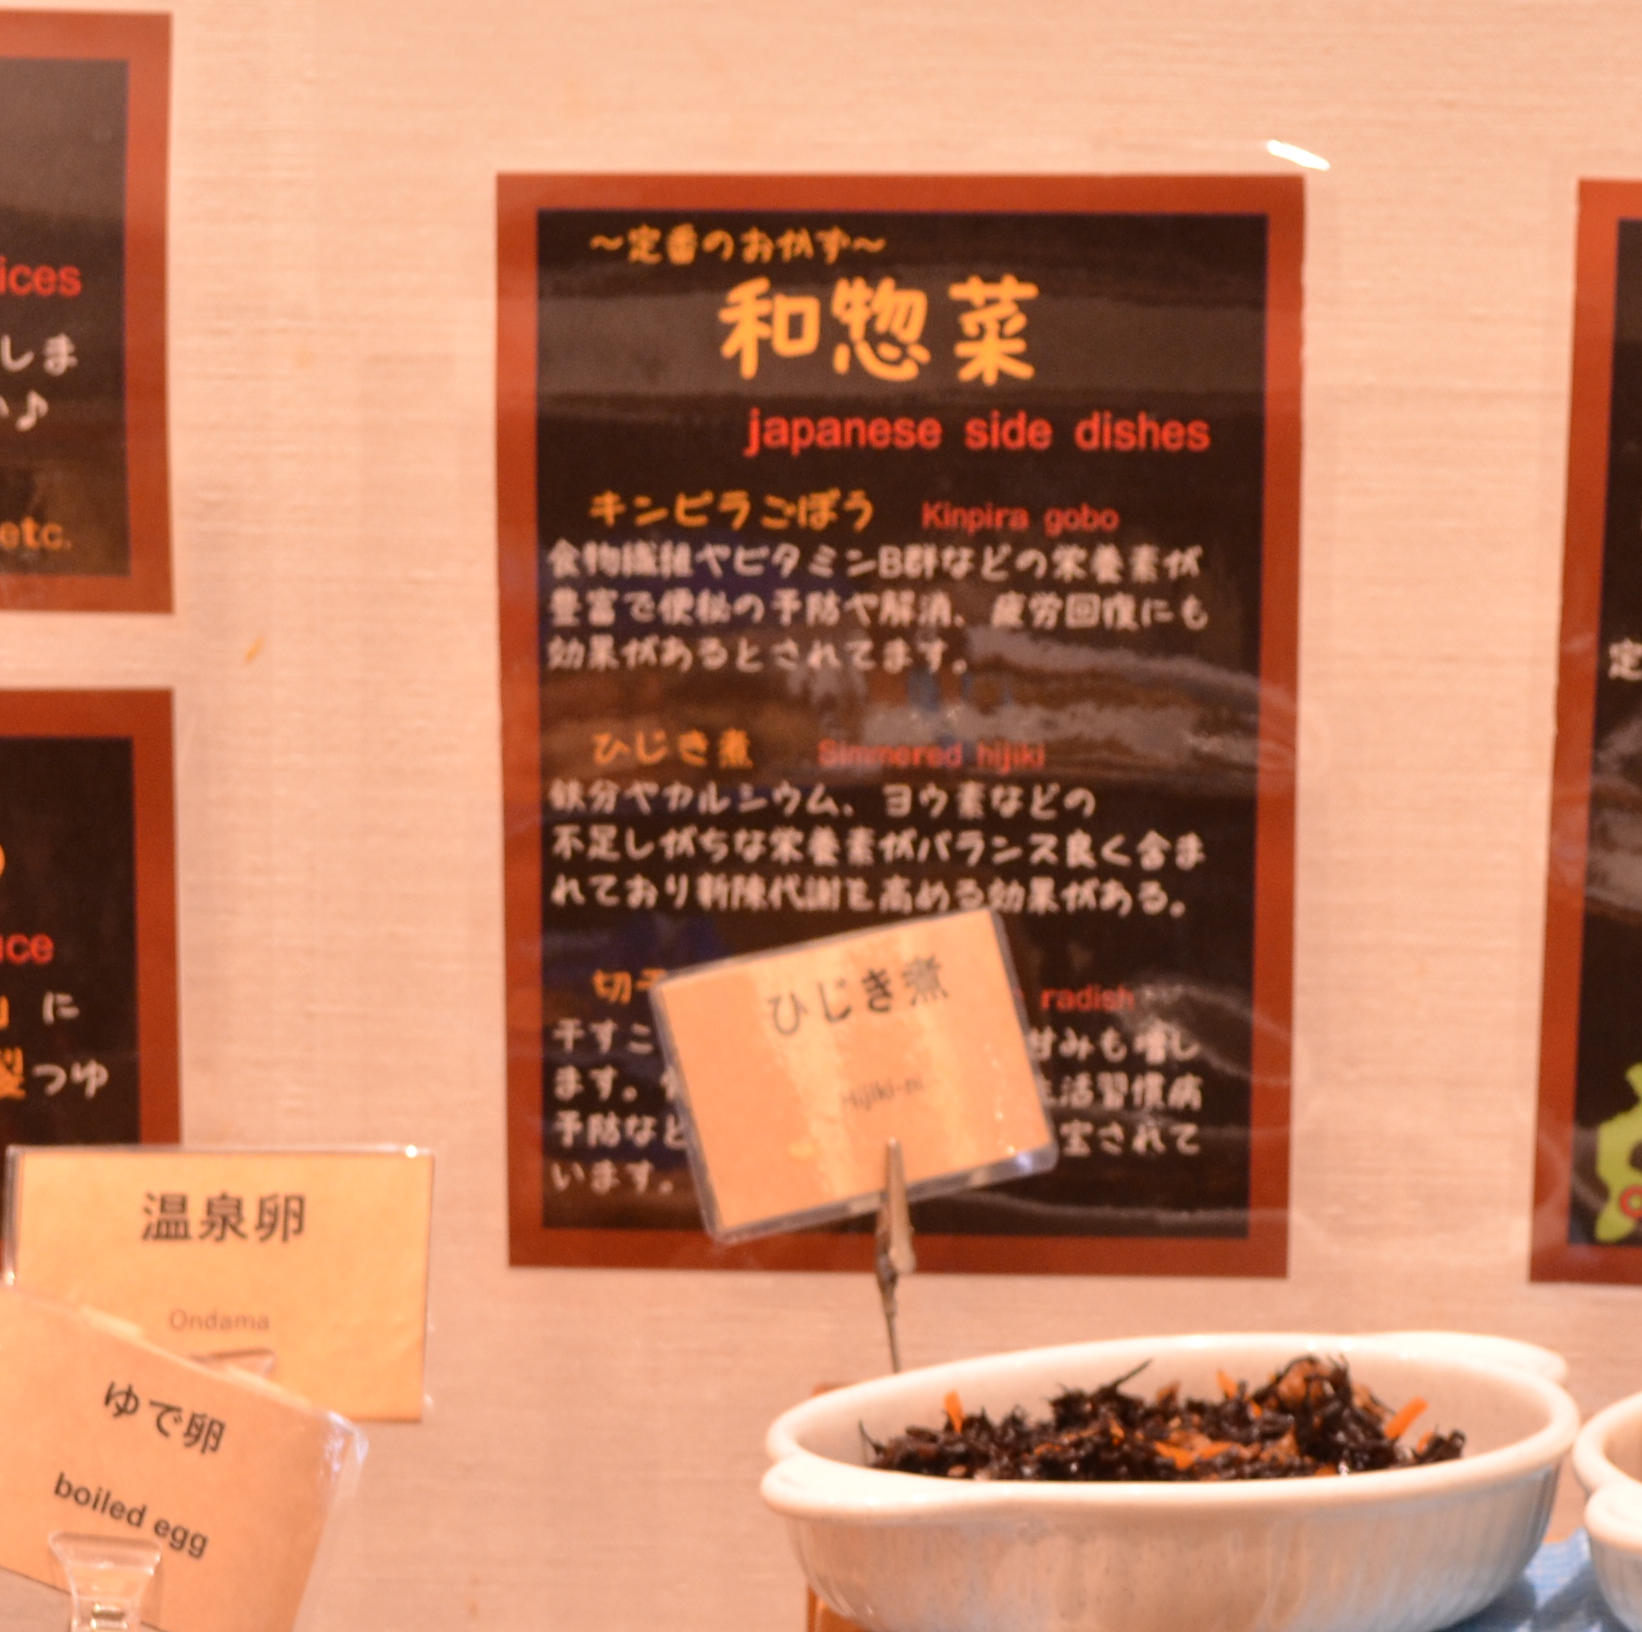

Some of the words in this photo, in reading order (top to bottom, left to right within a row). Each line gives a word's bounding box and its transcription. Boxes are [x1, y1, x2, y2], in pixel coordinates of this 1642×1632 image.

[720, 275, 1040, 385] 和惣菜
[744, 408, 941, 457] japanese
[964, 409, 1052, 449] side
[1075, 411, 1211, 452] dishes
[922, 501, 1028, 536] Kinpira
[1045, 504, 1120, 537] gobo
[592, 729, 754, 770] ひじき煮
[766, 954, 950, 1036] ひじき煮
[1040, 983, 1135, 1012] radish
[551, 1158, 675, 1195] います。
[141, 1191, 306, 1244] 温泉卵
[169, 1308, 271, 1331] Ondama
[103, 1381, 227, 1455] ゆで卵
[52, 1471, 147, 1529] boiled
[152, 1515, 210, 1559] egg
